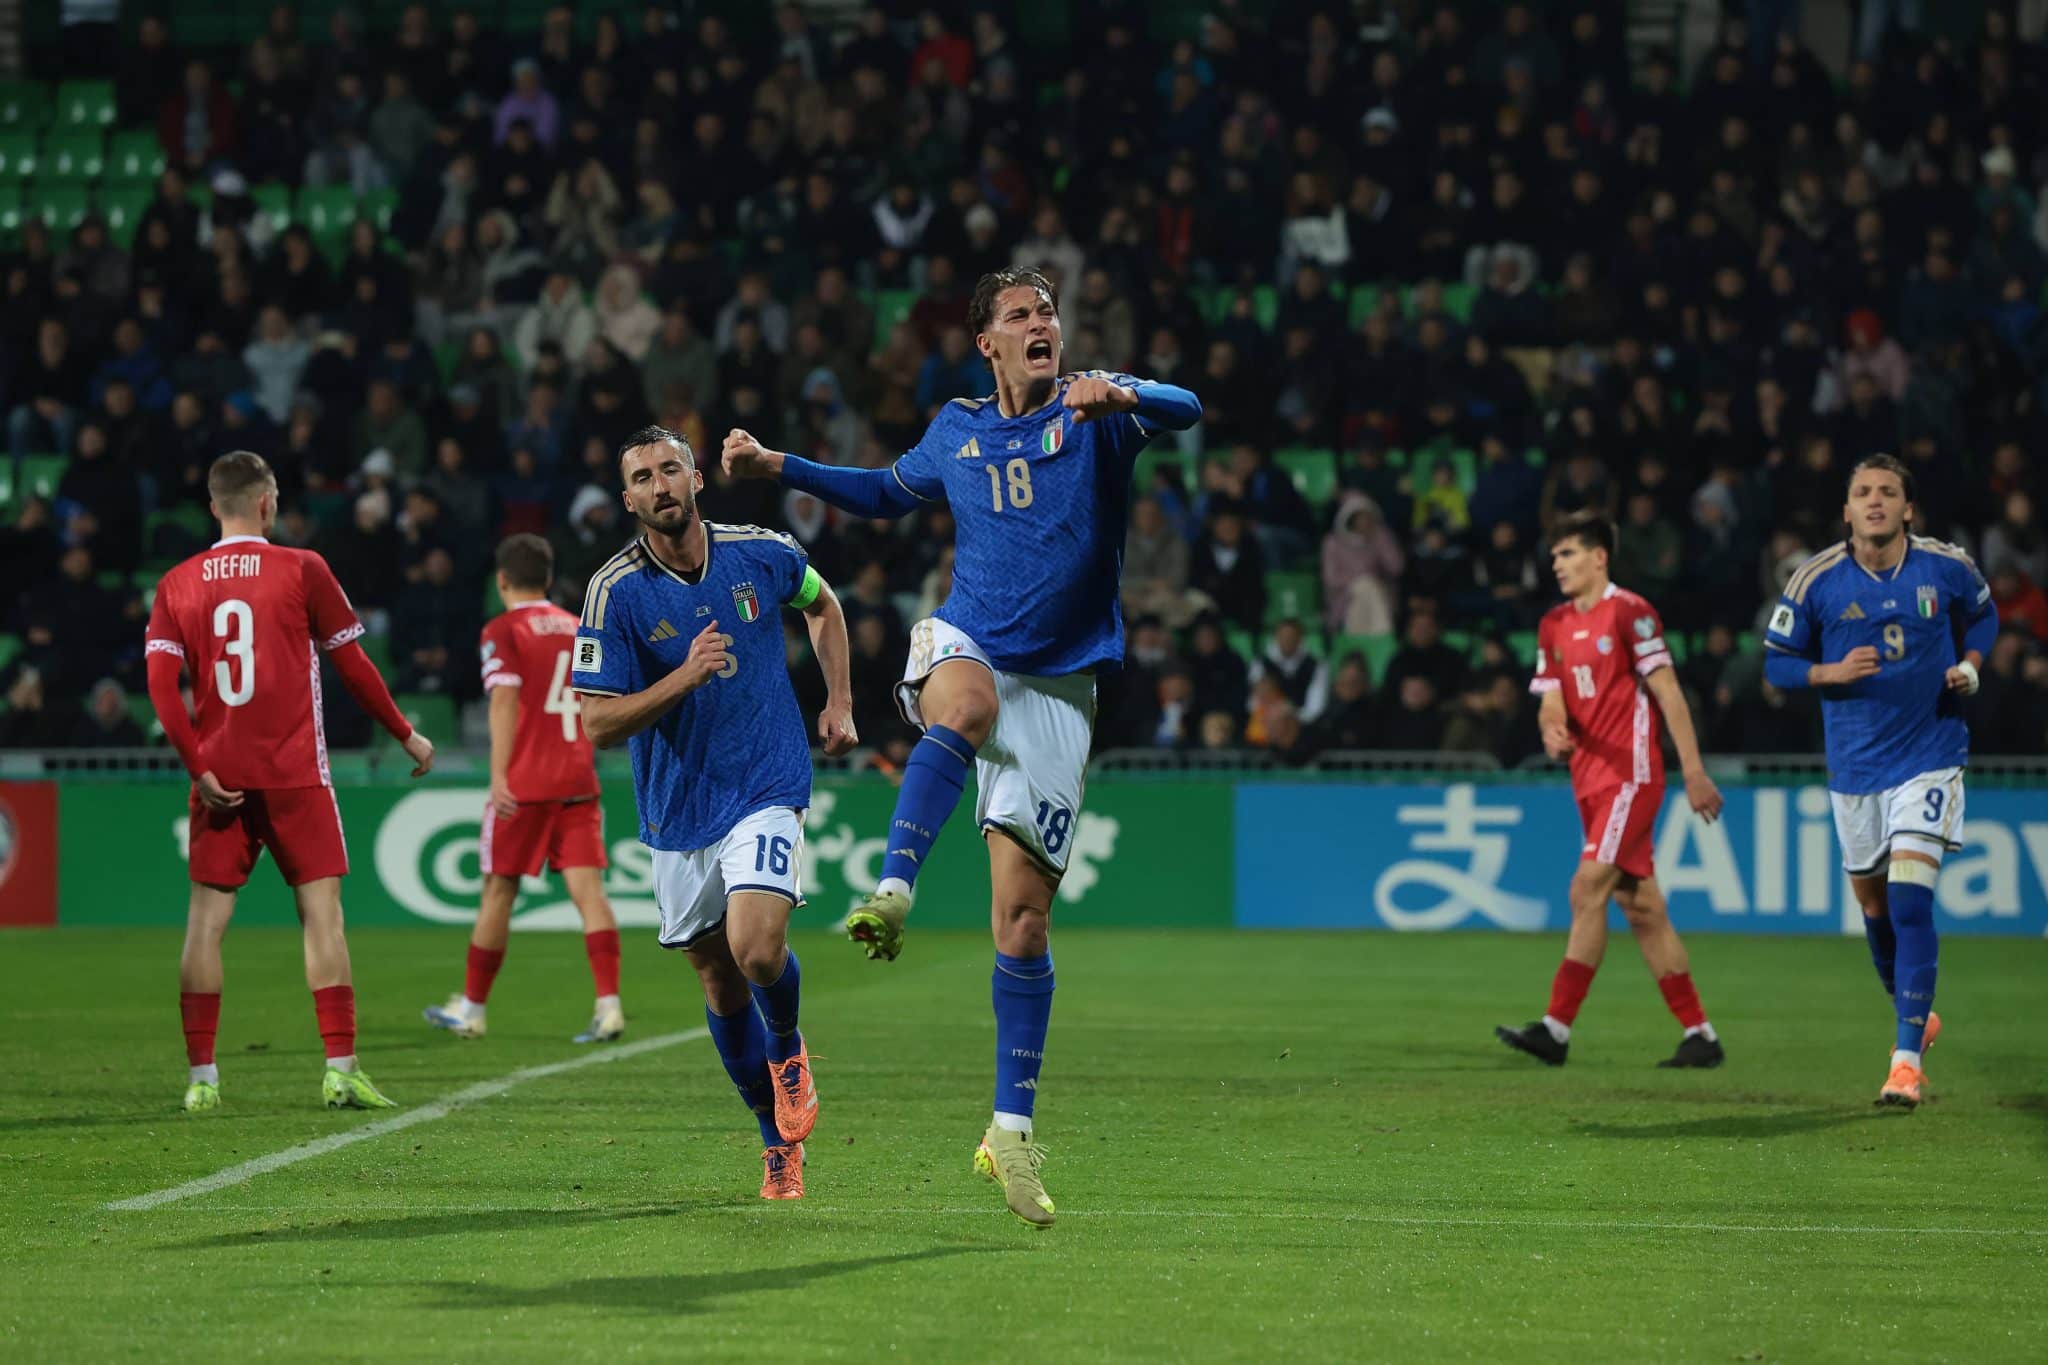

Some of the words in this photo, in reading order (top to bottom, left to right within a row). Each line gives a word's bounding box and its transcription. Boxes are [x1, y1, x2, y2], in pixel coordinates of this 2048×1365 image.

[985, 458, 1034, 513] 18
[202, 553, 261, 582] STEFAN
[213, 598, 256, 707] 3
[1883, 624, 1905, 661] 9
[543, 650, 582, 743] 4
[1922, 787, 1944, 823] 9
[895, 818, 931, 839] ITALIA
[1036, 800, 1072, 854] 18
[755, 834, 792, 876] 16
[1653, 785, 2048, 937] Alia
[1012, 1048, 1044, 1060] ITALI
